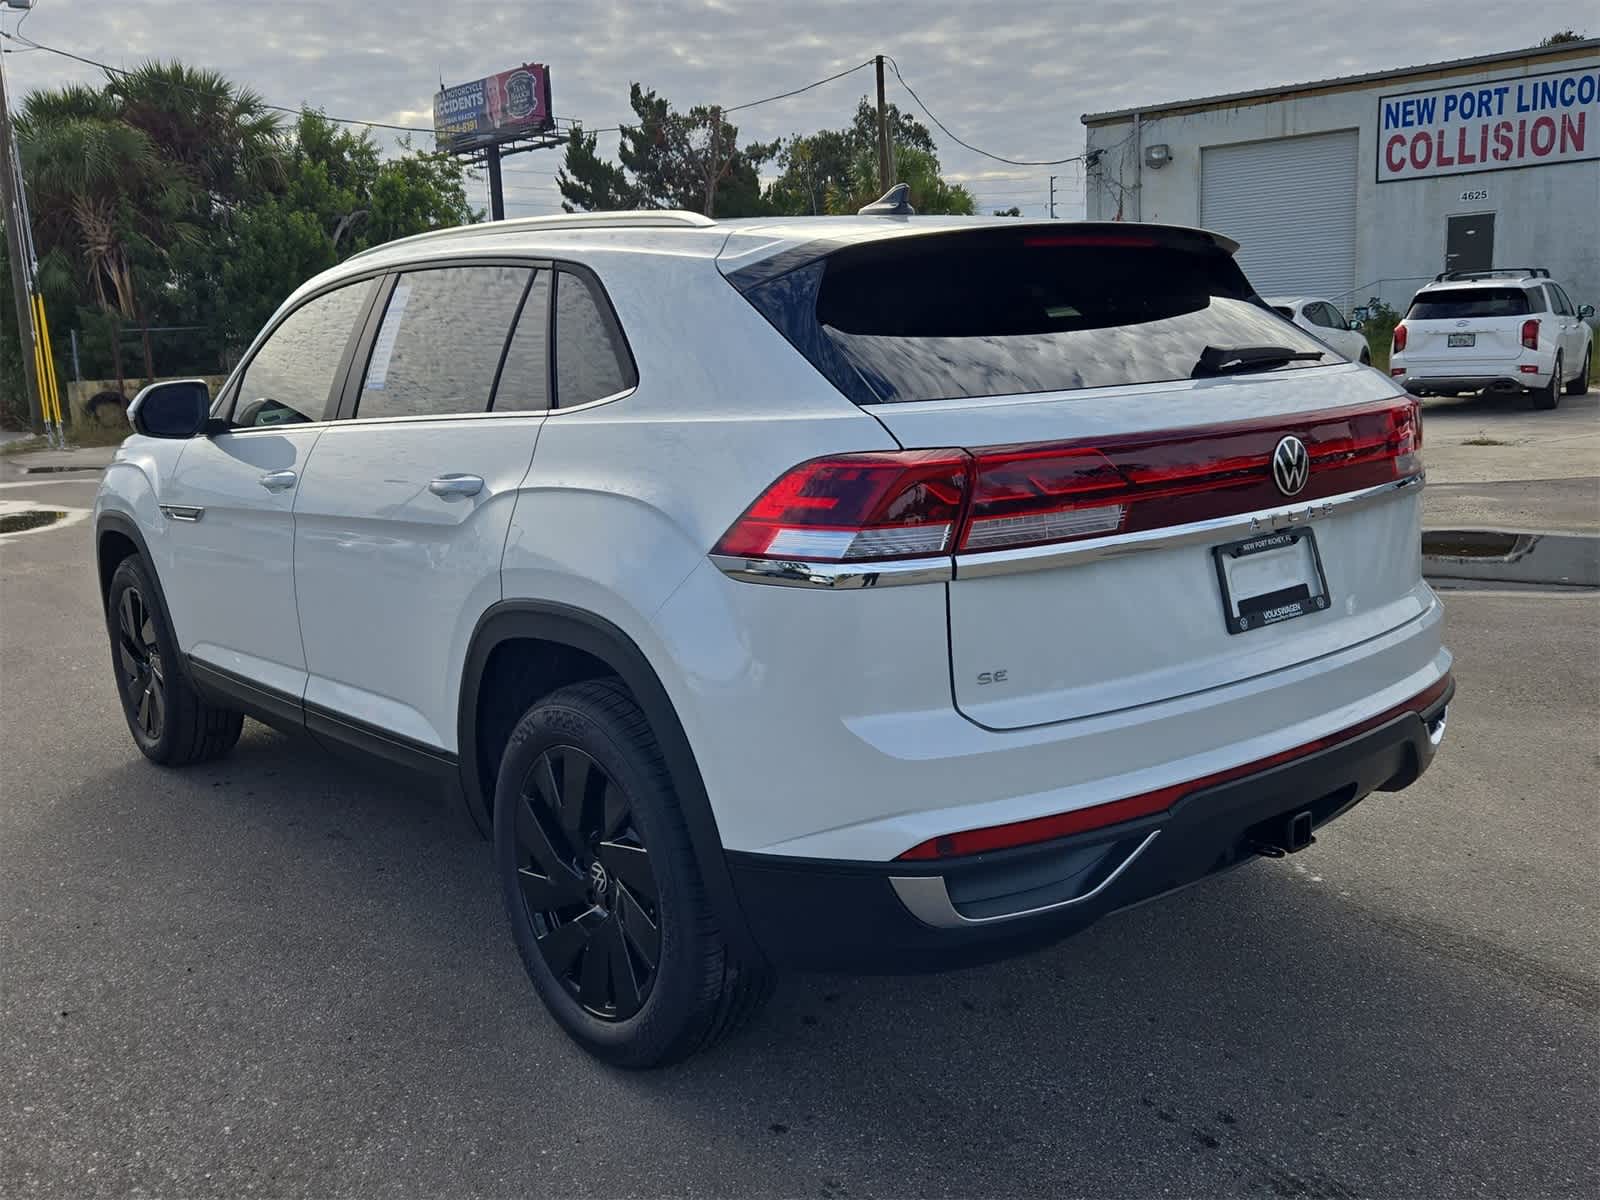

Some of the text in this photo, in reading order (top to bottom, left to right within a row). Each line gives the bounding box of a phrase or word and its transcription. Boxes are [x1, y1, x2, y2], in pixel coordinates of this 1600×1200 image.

[446, 82, 483, 99] MOTORCYCLE
[1385, 75, 1600, 130] NEW PORT LINCO
[1385, 112, 1586, 173] COLLISION
[1461, 190, 1488, 201] 4625
[1243, 543, 1255, 551] NEW
[1255, 539, 1267, 549] PORT
[1263, 602, 1301, 619] VOLKSWAGEN
[976, 670, 1008, 685] SE
